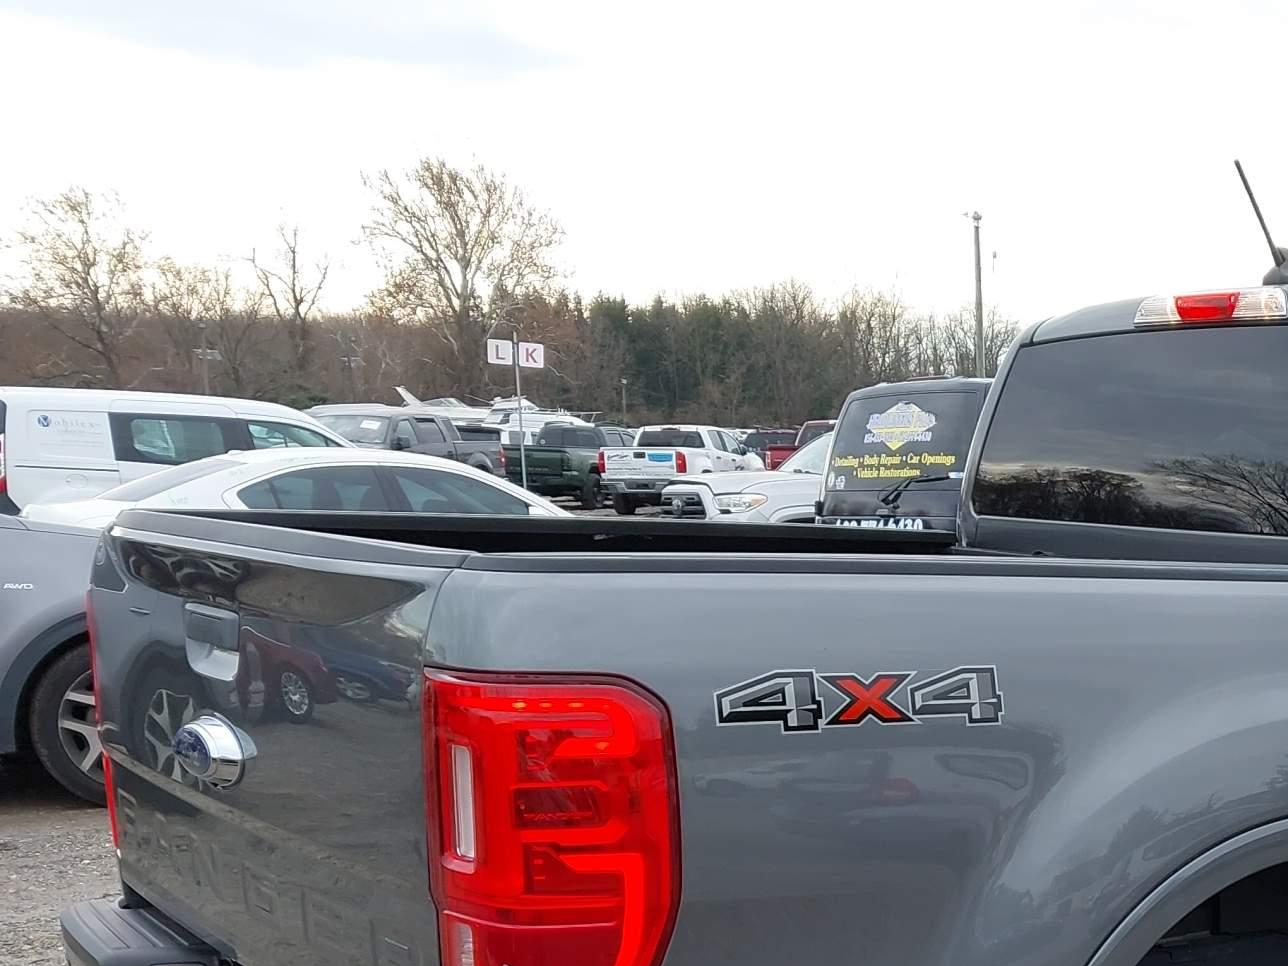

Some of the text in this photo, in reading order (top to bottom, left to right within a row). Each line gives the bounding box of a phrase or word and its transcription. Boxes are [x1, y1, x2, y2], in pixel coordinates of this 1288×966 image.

[495, 343, 538, 364] L K
[863, 454, 879, 467] Body
[879, 454, 901, 467] Repair
[906, 453, 920, 464] Car
[921, 453, 955, 466] Openings
[857, 467, 920, 478] Vehicle Restorations
[714, 665, 1004, 734] 4X4
